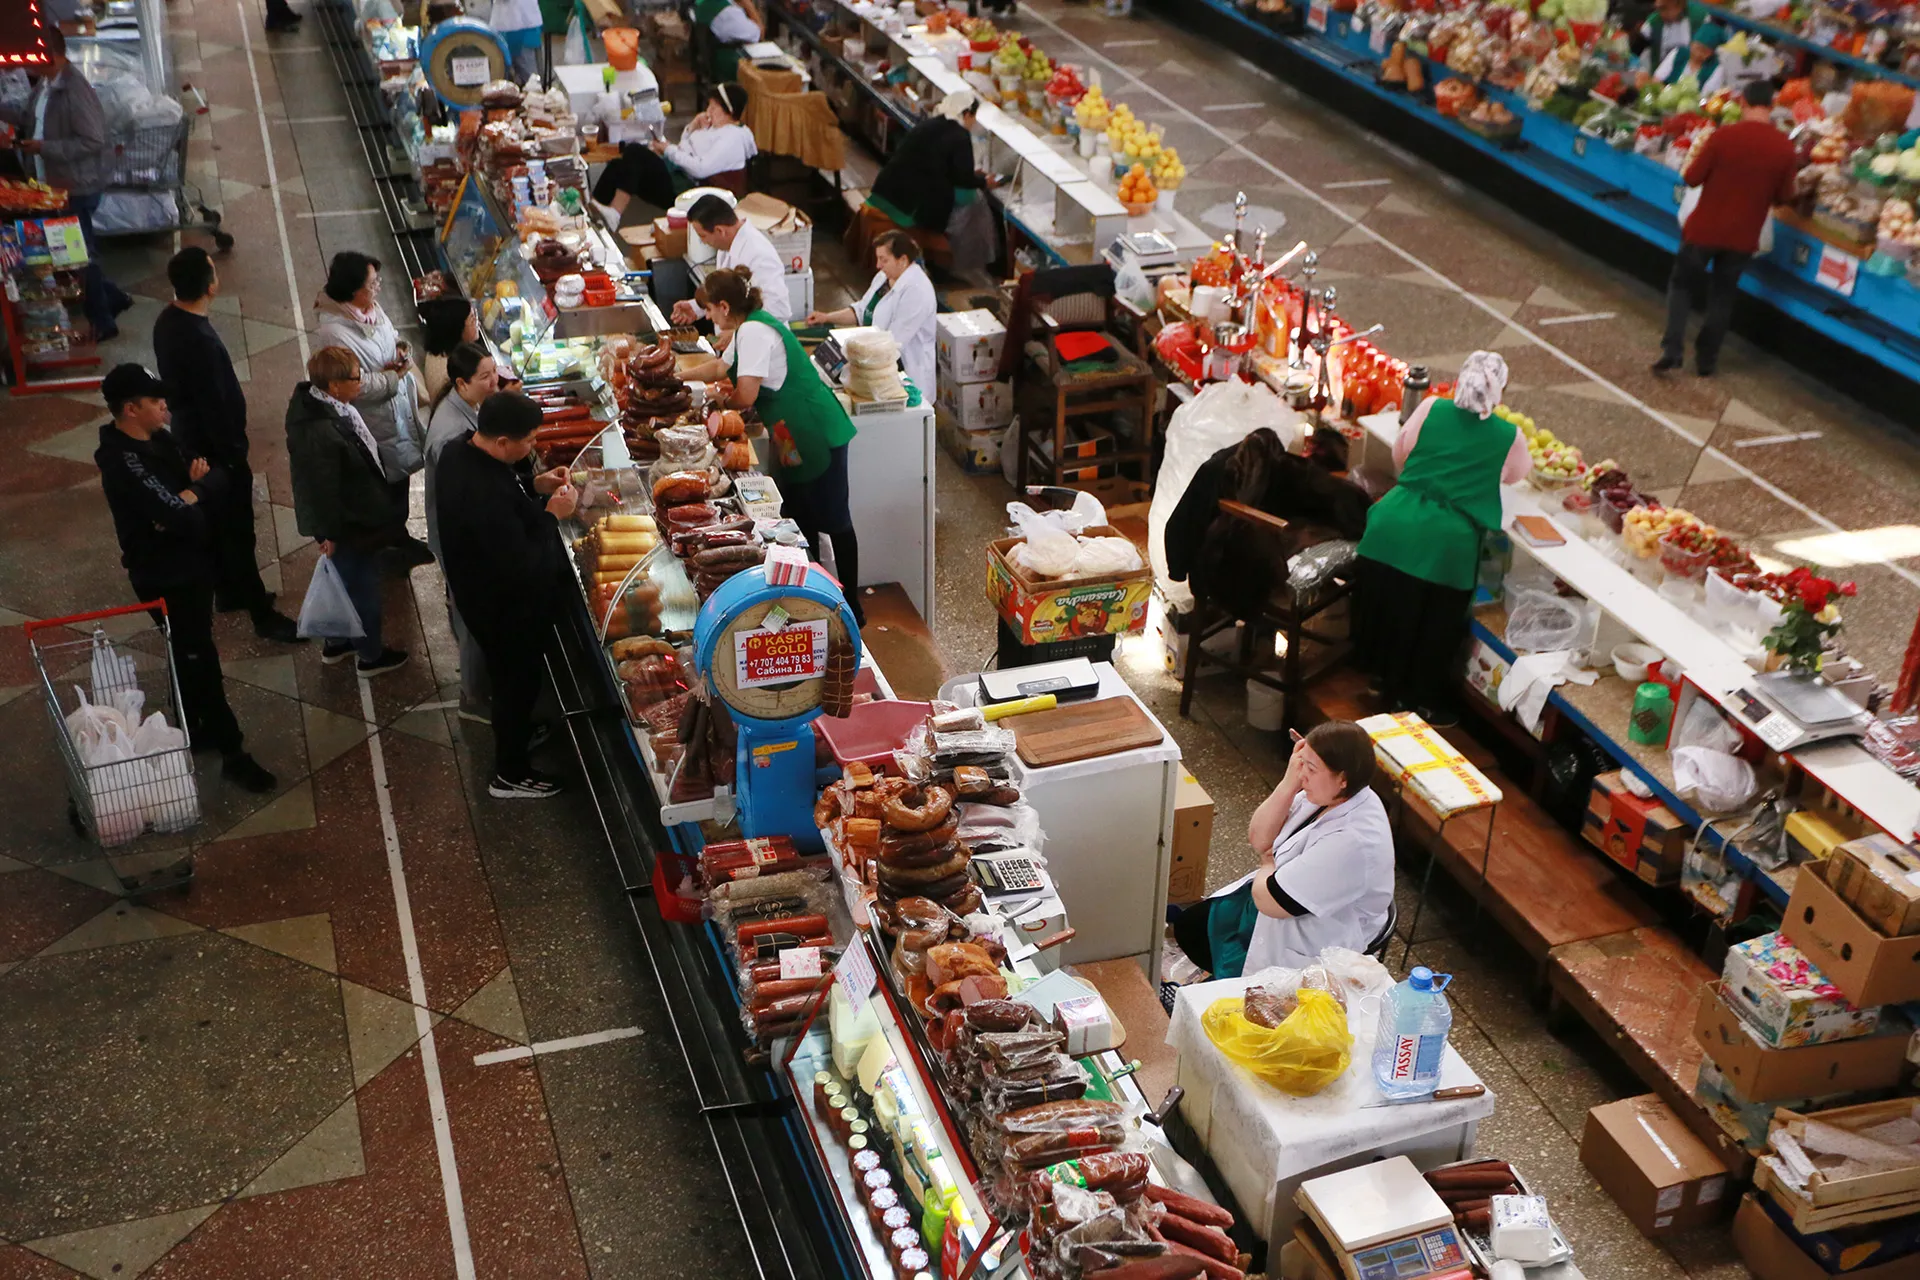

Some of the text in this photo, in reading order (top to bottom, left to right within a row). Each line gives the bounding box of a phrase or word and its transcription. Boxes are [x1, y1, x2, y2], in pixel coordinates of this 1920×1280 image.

[1056, 589, 1126, 606] Kassandra
[766, 633, 807, 645] KASPI
[767, 644, 806, 655] GOLD
[749, 659, 759, 668] +7
[760, 658, 773, 667] 707
[776, 657, 789, 665] 404
[791, 655, 801, 664] 79
[757, 666, 792, 675] Сабина
[794, 664, 805, 673] Д.
[1396, 1038, 1413, 1078] TASSAY
